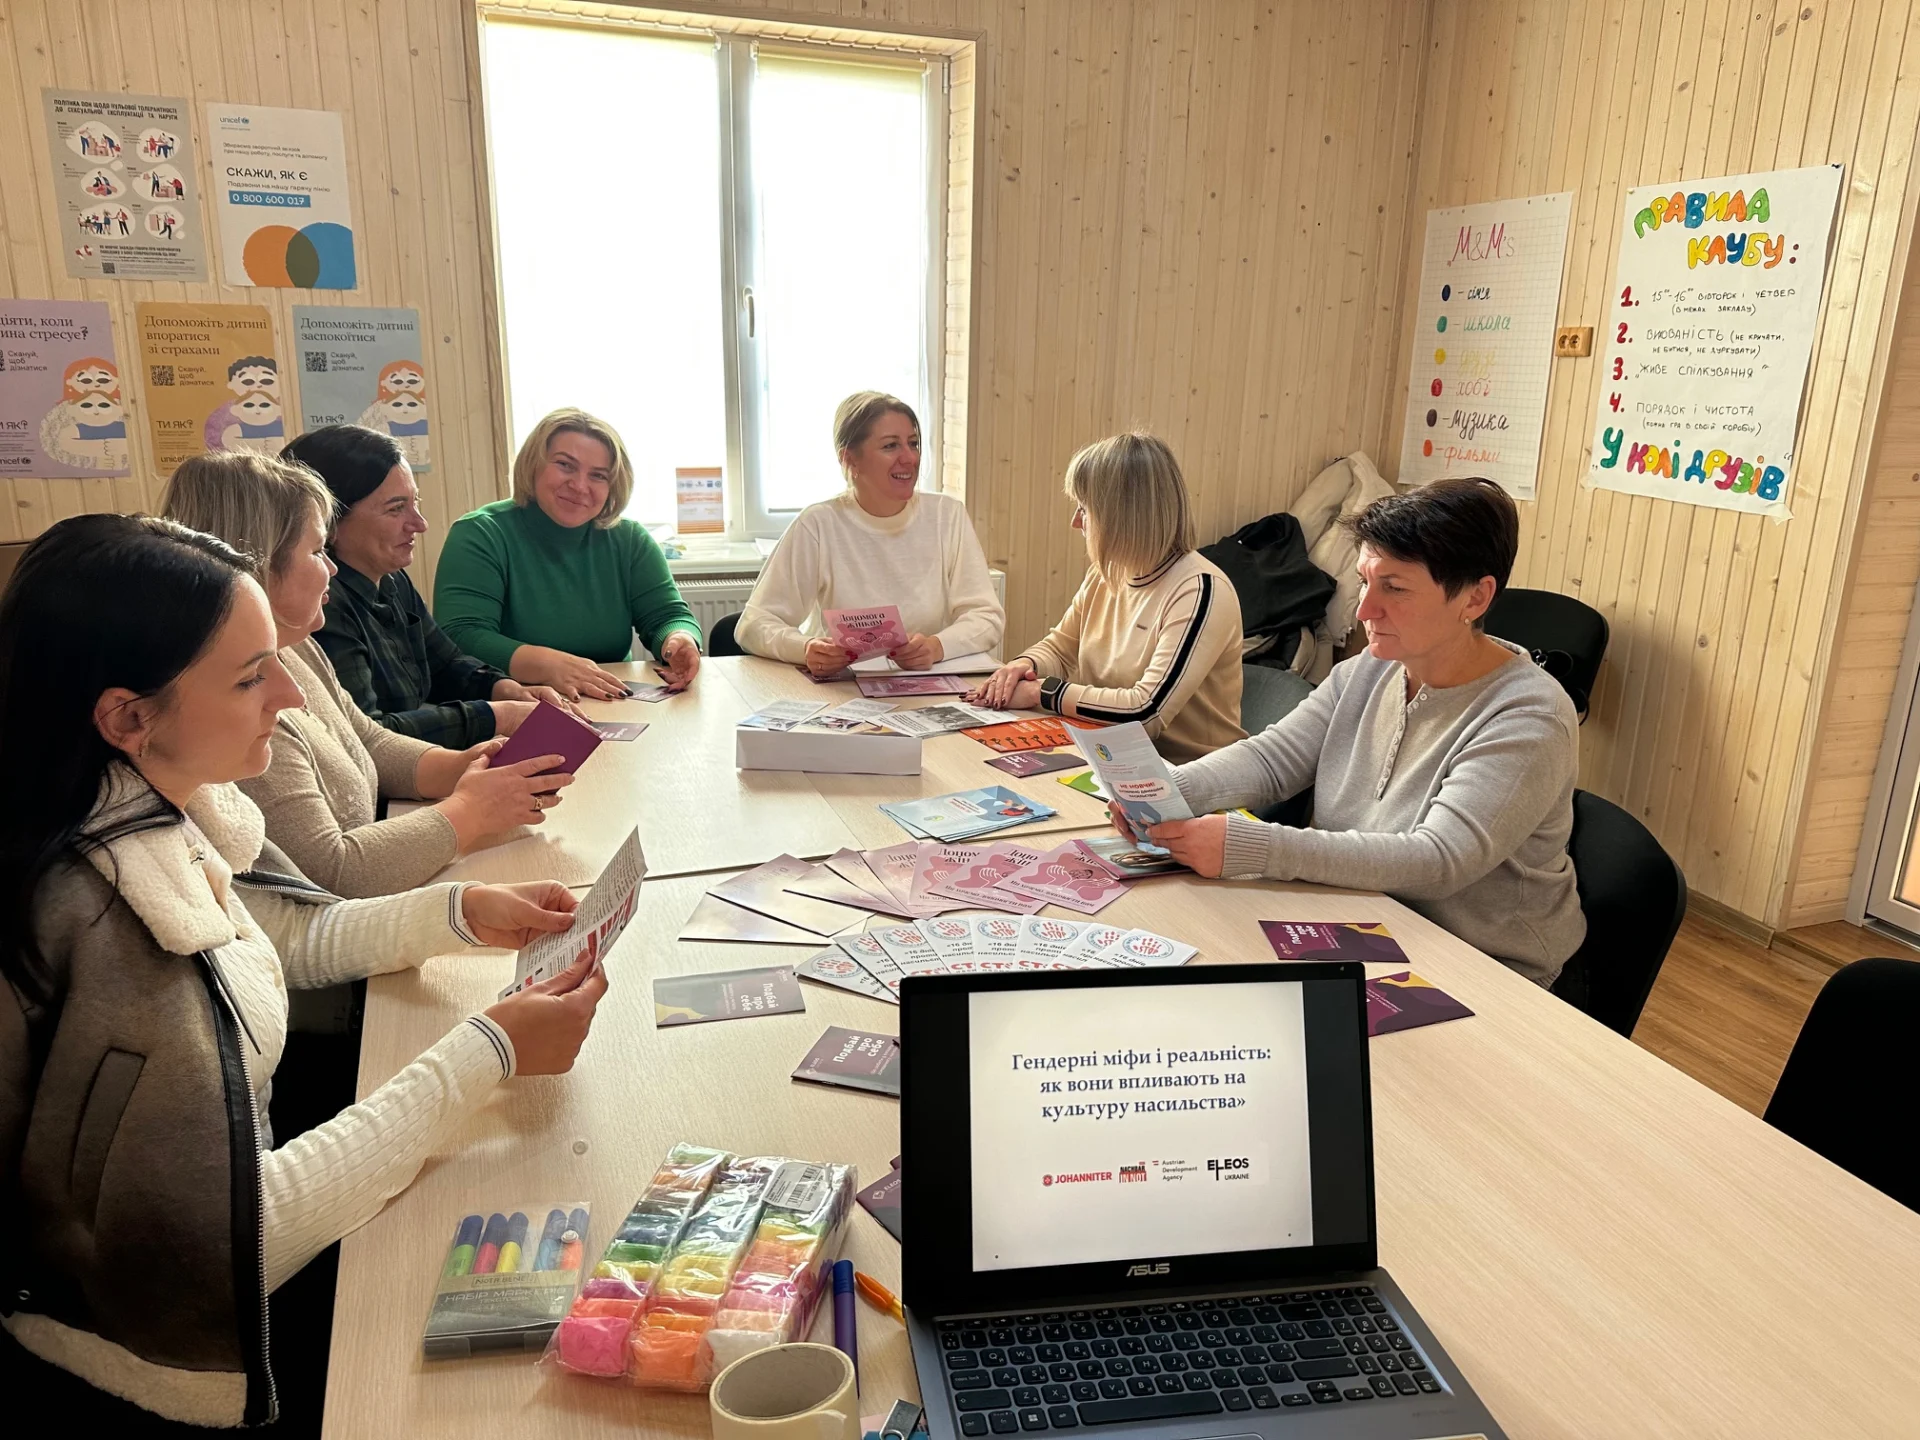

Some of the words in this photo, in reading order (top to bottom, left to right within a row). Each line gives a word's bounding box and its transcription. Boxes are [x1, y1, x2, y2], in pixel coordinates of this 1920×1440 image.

[219, 116, 241, 124] unicef
[226, 166, 277, 180] СКАЖИ,
[280, 170, 296, 180] ЯК
[299, 171, 308, 180] Є
[227, 181, 261, 189] Подзвони
[232, 193, 240, 202] 0
[242, 194, 263, 203] 800
[265, 195, 285, 204] 600
[287, 196, 305, 205] 017
[1634, 187, 1770, 239] ПРАВИЛА
[1620, 286, 1640, 308] 1.
[1755, 288, 1796, 298] ЧЕТВЕР
[41, 318, 73, 327] коли
[144, 315, 224, 329] Допоможіть
[226, 319, 267, 330] дитині
[300, 317, 374, 330] Допоможіть
[376, 321, 414, 331] дитині
[1463, 314, 1511, 332] школа
[146, 333, 210, 343] впоратися
[301, 332, 376, 342] заспокоїтися
[1616, 322, 1633, 345] 2.
[8, 350, 39, 359] Скануй,
[148, 344, 158, 354] зі
[161, 346, 220, 357] страхами
[330, 352, 357, 360] Скануй,
[9, 357, 26, 365] щоб
[10, 364, 48, 372] дізнатися
[1612, 356, 1628, 381] 3.
[180, 379, 215, 387] дізнатися
[1456, 375, 1491, 397] хобі
[1609, 391, 1625, 413] 4.
[1636, 402, 1686, 416] ПОРЯДОК
[1705, 405, 1754, 417] ЧИСТОТА
[156, 420, 171, 429] ТИ
[172, 419, 193, 429] ЯК?
[310, 415, 324, 424] ТИ
[325, 413, 345, 424] ЯК?
[0, 456, 21, 465] nicef
[1444, 445, 1501, 469] фільми
[1626, 439, 1681, 480] КОЛІ
[832, 1035, 861, 1063] Подбай
[857, 1037, 873, 1052] про
[867, 1039, 885, 1057] себе
[1012, 1050, 1098, 1072] Гендерні
[1103, 1049, 1151, 1070] міфи
[1156, 1048, 1162, 1064] і
[1167, 1045, 1272, 1068] реальність:
[1040, 1080, 1062, 1093] як
[1067, 1078, 1113, 1092] вони
[1119, 1072, 1220, 1089] впливають
[1224, 1072, 1246, 1085] на
[1042, 1101, 1130, 1122] культуру
[1134, 1095, 1246, 1113] насильства»
[1120, 1165, 1146, 1173] NACHBAR
[1207, 1157, 1250, 1181] ELEOS
[1055, 1171, 1113, 1184] JOHANNITER
[1162, 1174, 1183, 1182] Agency
[1126, 1262, 1171, 1277] ASUS
